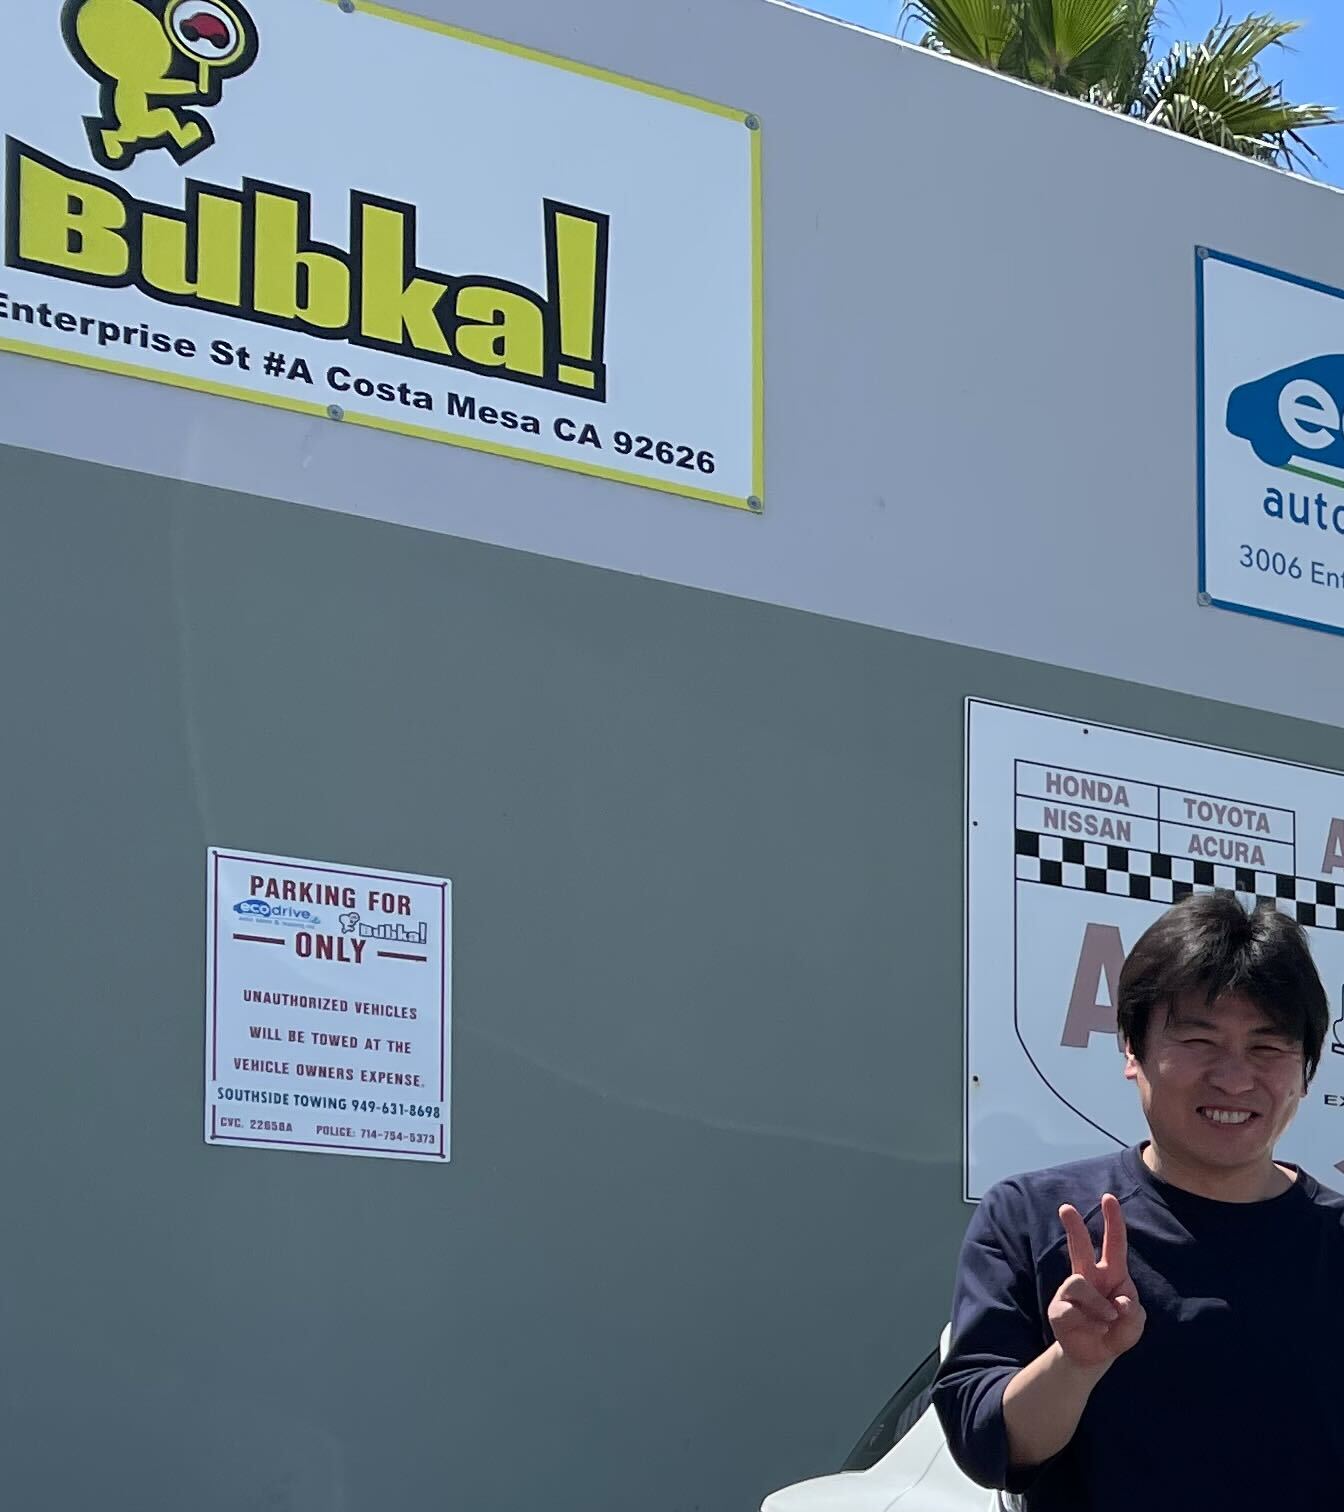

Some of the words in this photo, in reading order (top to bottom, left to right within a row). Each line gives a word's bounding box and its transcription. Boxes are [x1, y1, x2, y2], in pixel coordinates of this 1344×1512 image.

[5, 133, 609, 403] Bubka!
[210, 339, 250, 371] St
[263, 351, 314, 385] #A
[326, 366, 433, 411] Costa
[448, 393, 540, 435] Mesa
[554, 417, 602, 449] CA
[614, 431, 716, 474] 92626
[1239, 543, 1303, 580] 3006
[1045, 771, 1131, 808] HONDA
[1043, 805, 1132, 842] NISSAN
[1183, 797, 1271, 834] TOYOTA
[1187, 833, 1266, 866] ACURA
[250, 874, 356, 909] PARKING
[368, 890, 412, 916] FOR
[295, 931, 367, 964] ONLY
[243, 989, 348, 1012] UNAUTHORIZED
[354, 1001, 417, 1020] VEHICLES
[249, 1026, 282, 1041] WILL
[288, 1030, 305, 1044] BE
[311, 1032, 358, 1048] TOWED
[364, 1038, 381, 1051] AT
[387, 1040, 412, 1054] THE
[233, 1057, 289, 1075] VEHICLE
[296, 1063, 354, 1081] OWNERS
[360, 1069, 425, 1088] EXPENSE.
[217, 1087, 289, 1106] SOUTHSIDE
[293, 1094, 347, 1111] TOWING
[351, 1099, 440, 1119] 949-631-8698
